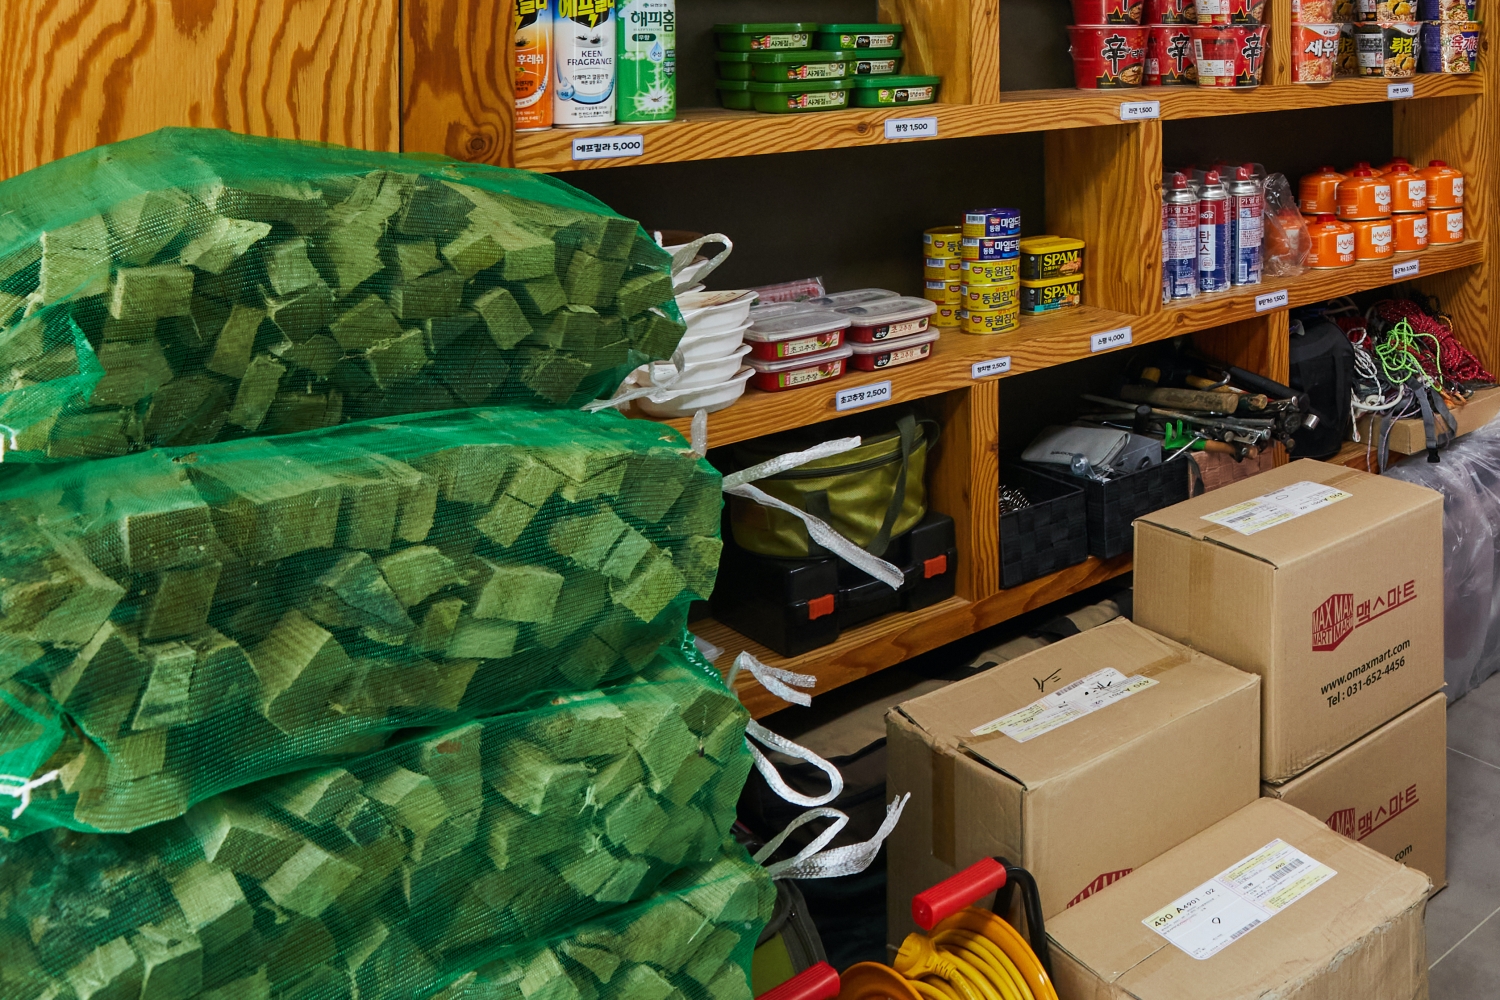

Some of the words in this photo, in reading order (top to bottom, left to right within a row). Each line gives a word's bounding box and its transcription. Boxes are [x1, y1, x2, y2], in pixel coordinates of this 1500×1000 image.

[631, 10, 674, 32] 해피홈
[567, 58, 612, 66] FRAGRANCE
[909, 123, 928, 131] 1,500
[576, 143, 611, 152] 에프킬라
[613, 141, 641, 151] 5,000
[1043, 251, 1078, 267] SPAM
[1043, 283, 1078, 299] SPAM
[1108, 333, 1125, 342] 4,000
[840, 392, 865, 404] 초고추장
[866, 387, 887, 398] 2,500
[1334, 595, 1353, 624] MAX
[1355, 579, 1417, 628] 맥스마트
[1312, 597, 1333, 632] MAX
[1313, 629, 1332, 646] MART
[1320, 640, 1410, 695] www.omaxmart.com
[1327, 691, 1340, 708] Tel
[1346, 656, 1405, 697] 031-652-4456
[1356, 783, 1419, 842] 맥스마트
[1154, 913, 1174, 927] 490
[1175, 897, 1201, 914] A4901
[1205, 888, 1215, 896] 02
